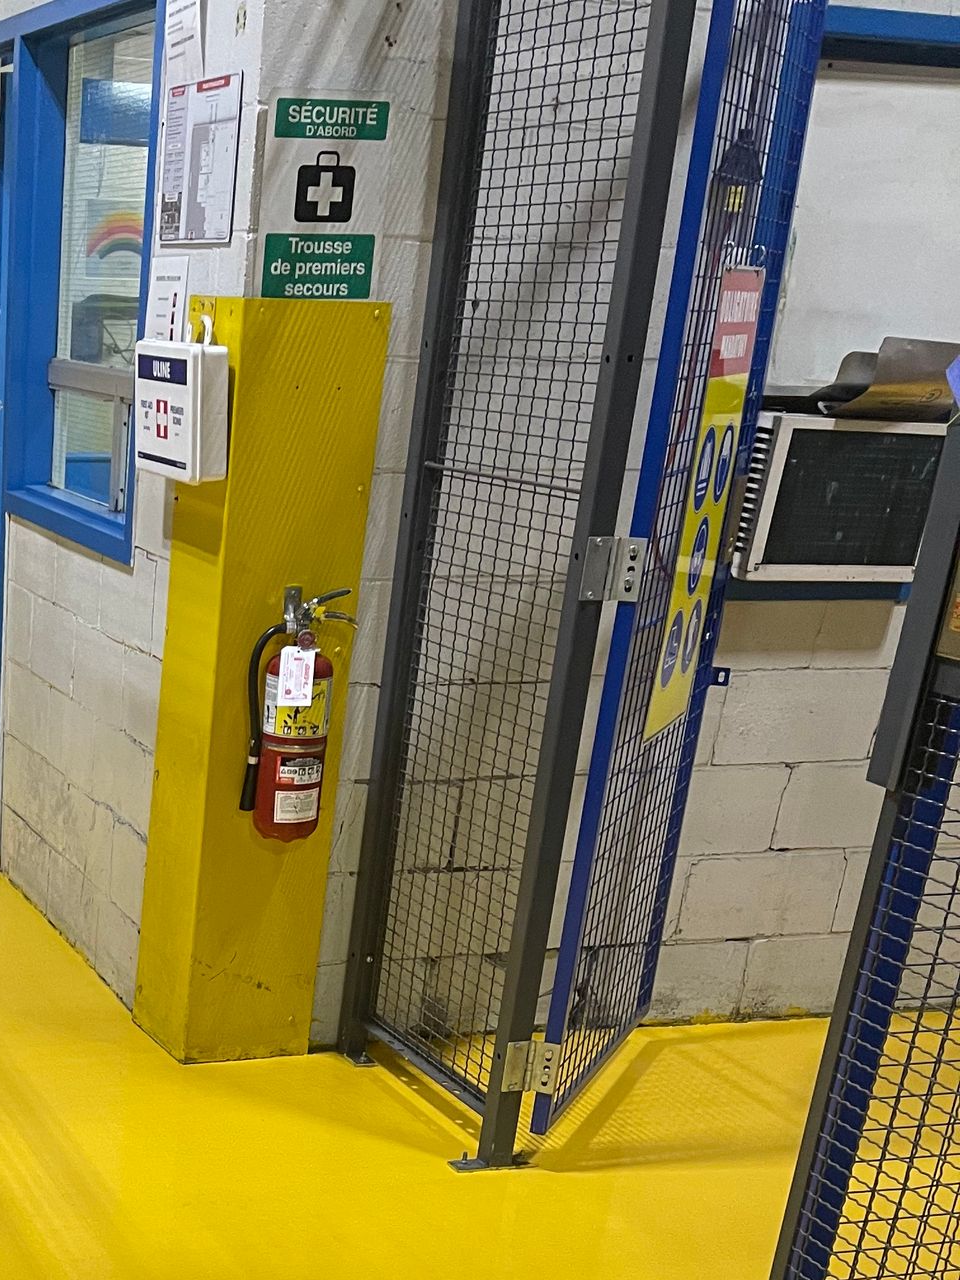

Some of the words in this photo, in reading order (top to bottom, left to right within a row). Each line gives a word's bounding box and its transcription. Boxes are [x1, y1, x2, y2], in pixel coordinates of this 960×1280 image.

[288, 101, 378, 125] SÉCURITÉ
[305, 125, 357, 137] D'ABORD
[288, 237, 353, 254] Trousse
[270, 258, 291, 275] de
[295, 259, 366, 279] premiers
[284, 283, 349, 296] secours
[152, 360, 171, 379] ULINE
